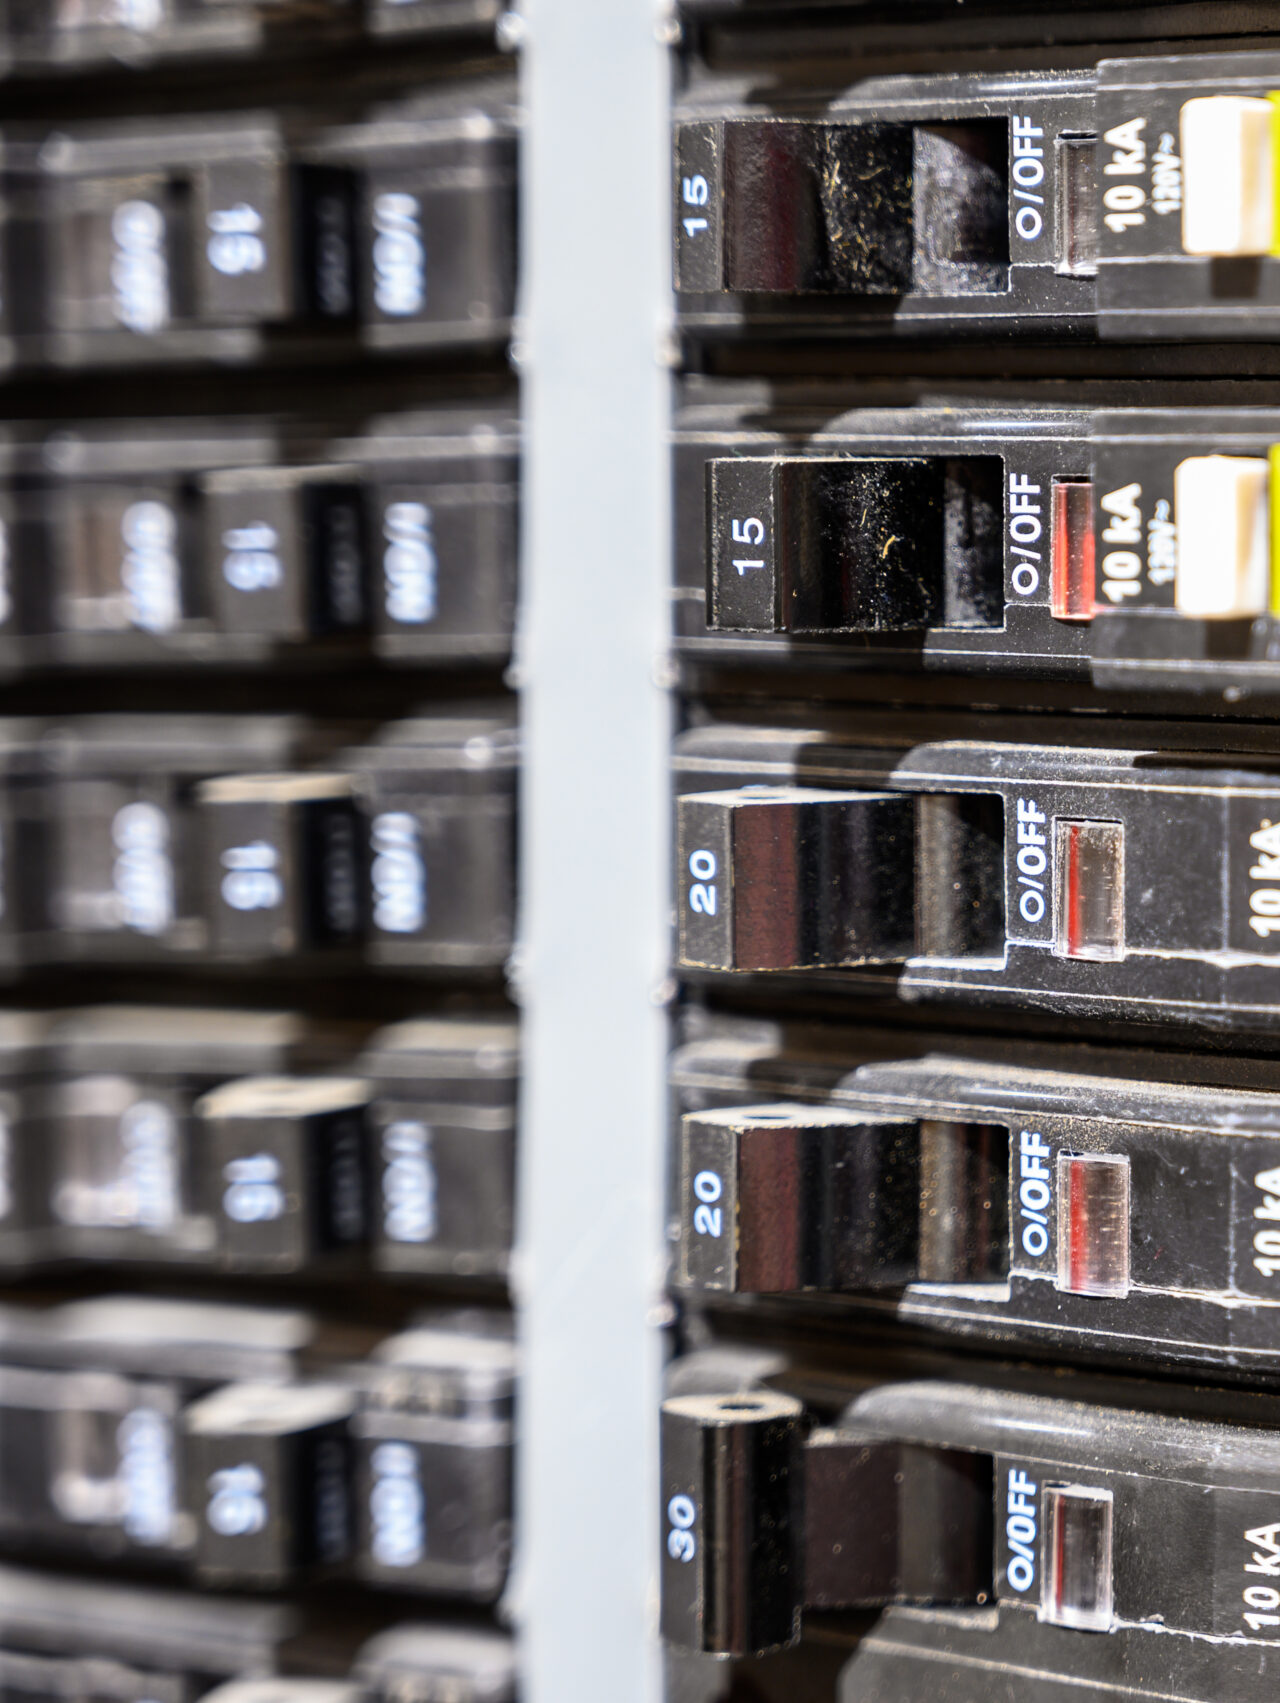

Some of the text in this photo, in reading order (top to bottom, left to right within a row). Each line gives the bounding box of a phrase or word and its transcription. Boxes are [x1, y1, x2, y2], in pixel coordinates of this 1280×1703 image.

[683, 173, 708, 238] 15
[1012, 115, 1044, 240] O/OFF
[1103, 117, 1147, 233] 10 kA
[732, 517, 765, 576] 15
[1010, 473, 1042, 596] O/OFF
[1101, 483, 1141, 603] 10 kA
[689, 849, 717, 917] 20
[1018, 798, 1048, 924] O/OFF
[694, 1170, 723, 1239] 20
[1020, 1130, 1052, 1257] O/OFF
[668, 1495, 695, 1562] 30
[1007, 1469, 1036, 1591] O/OFF
